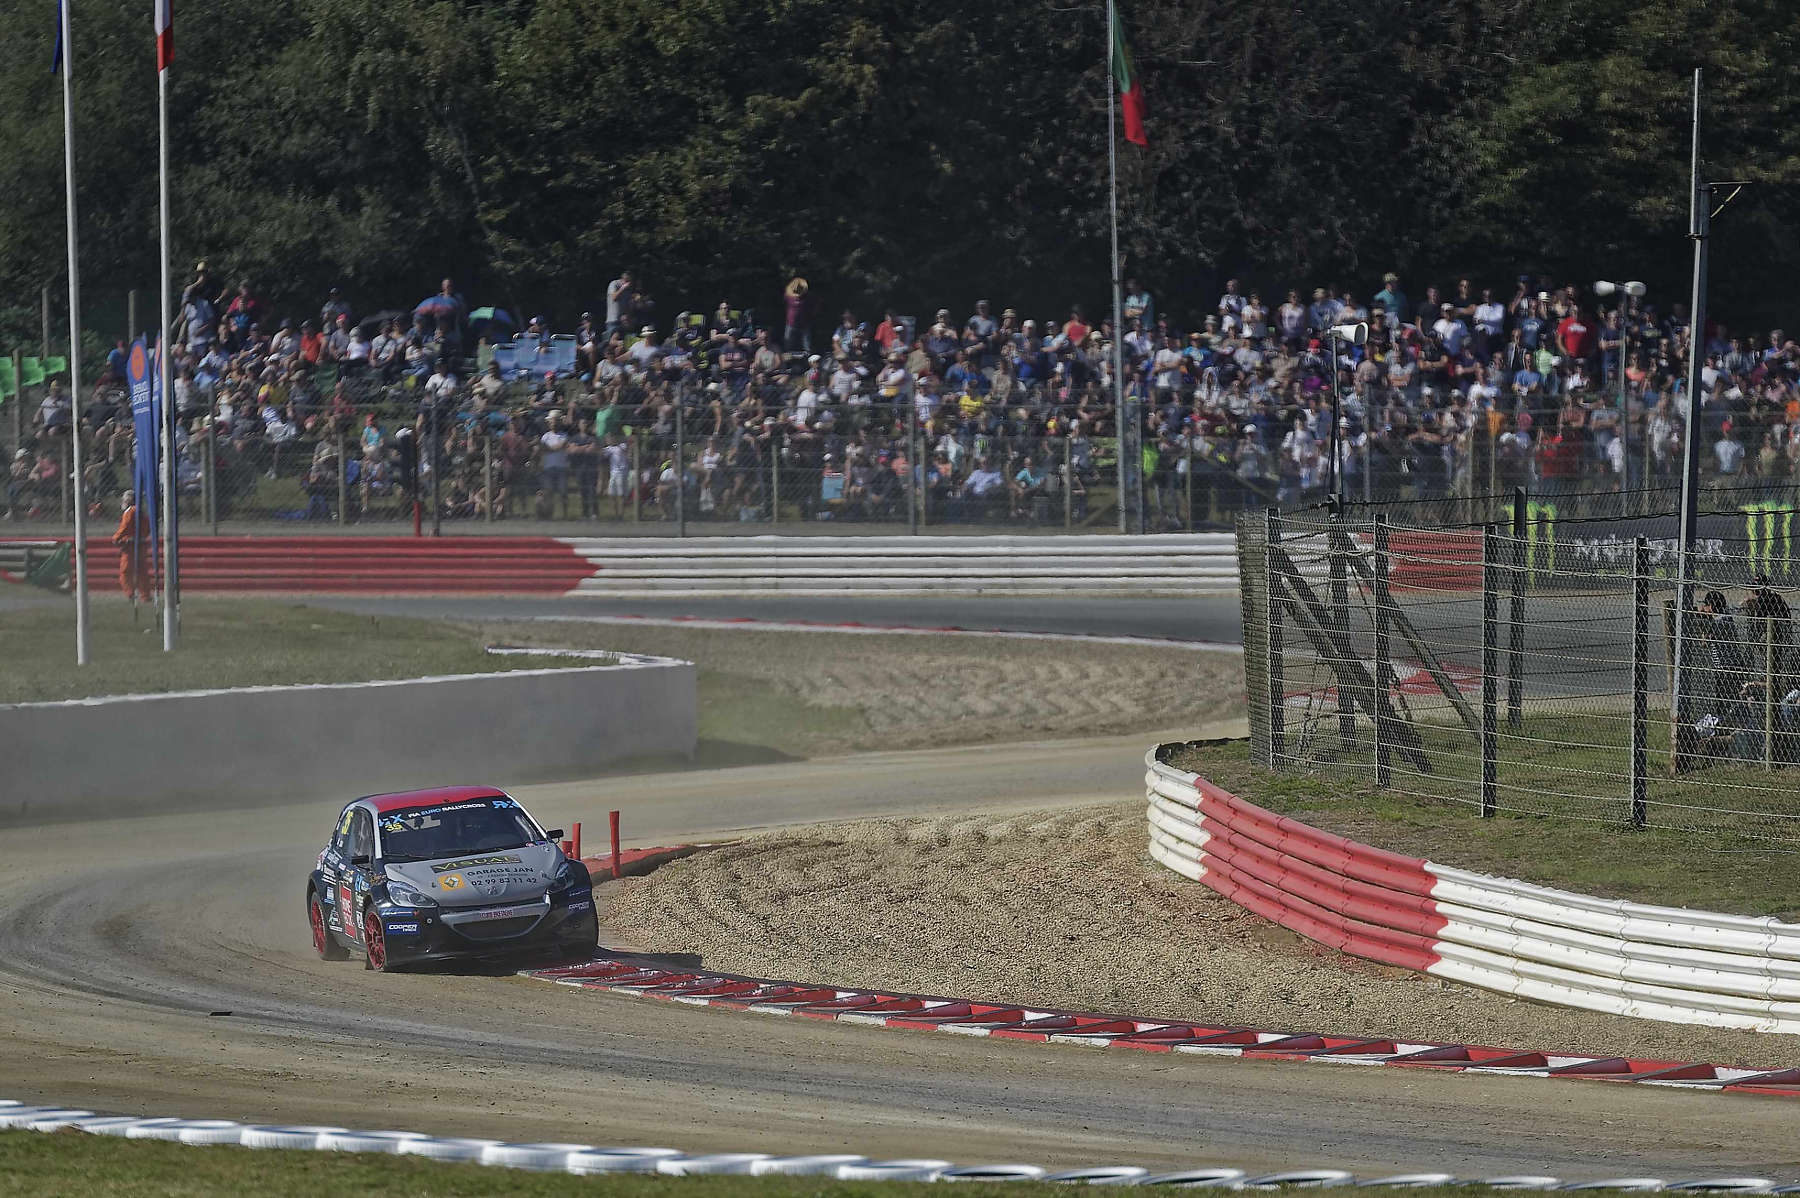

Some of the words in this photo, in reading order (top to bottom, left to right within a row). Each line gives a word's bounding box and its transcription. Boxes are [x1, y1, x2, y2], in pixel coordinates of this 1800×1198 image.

[442, 804, 486, 812] RALLYCROSS
[385, 823, 402, 832] 35
[467, 867, 511, 876] GARAGE
[471, 879, 483, 887] 02
[486, 878, 497, 886] 99
[526, 876, 537, 884] 42
